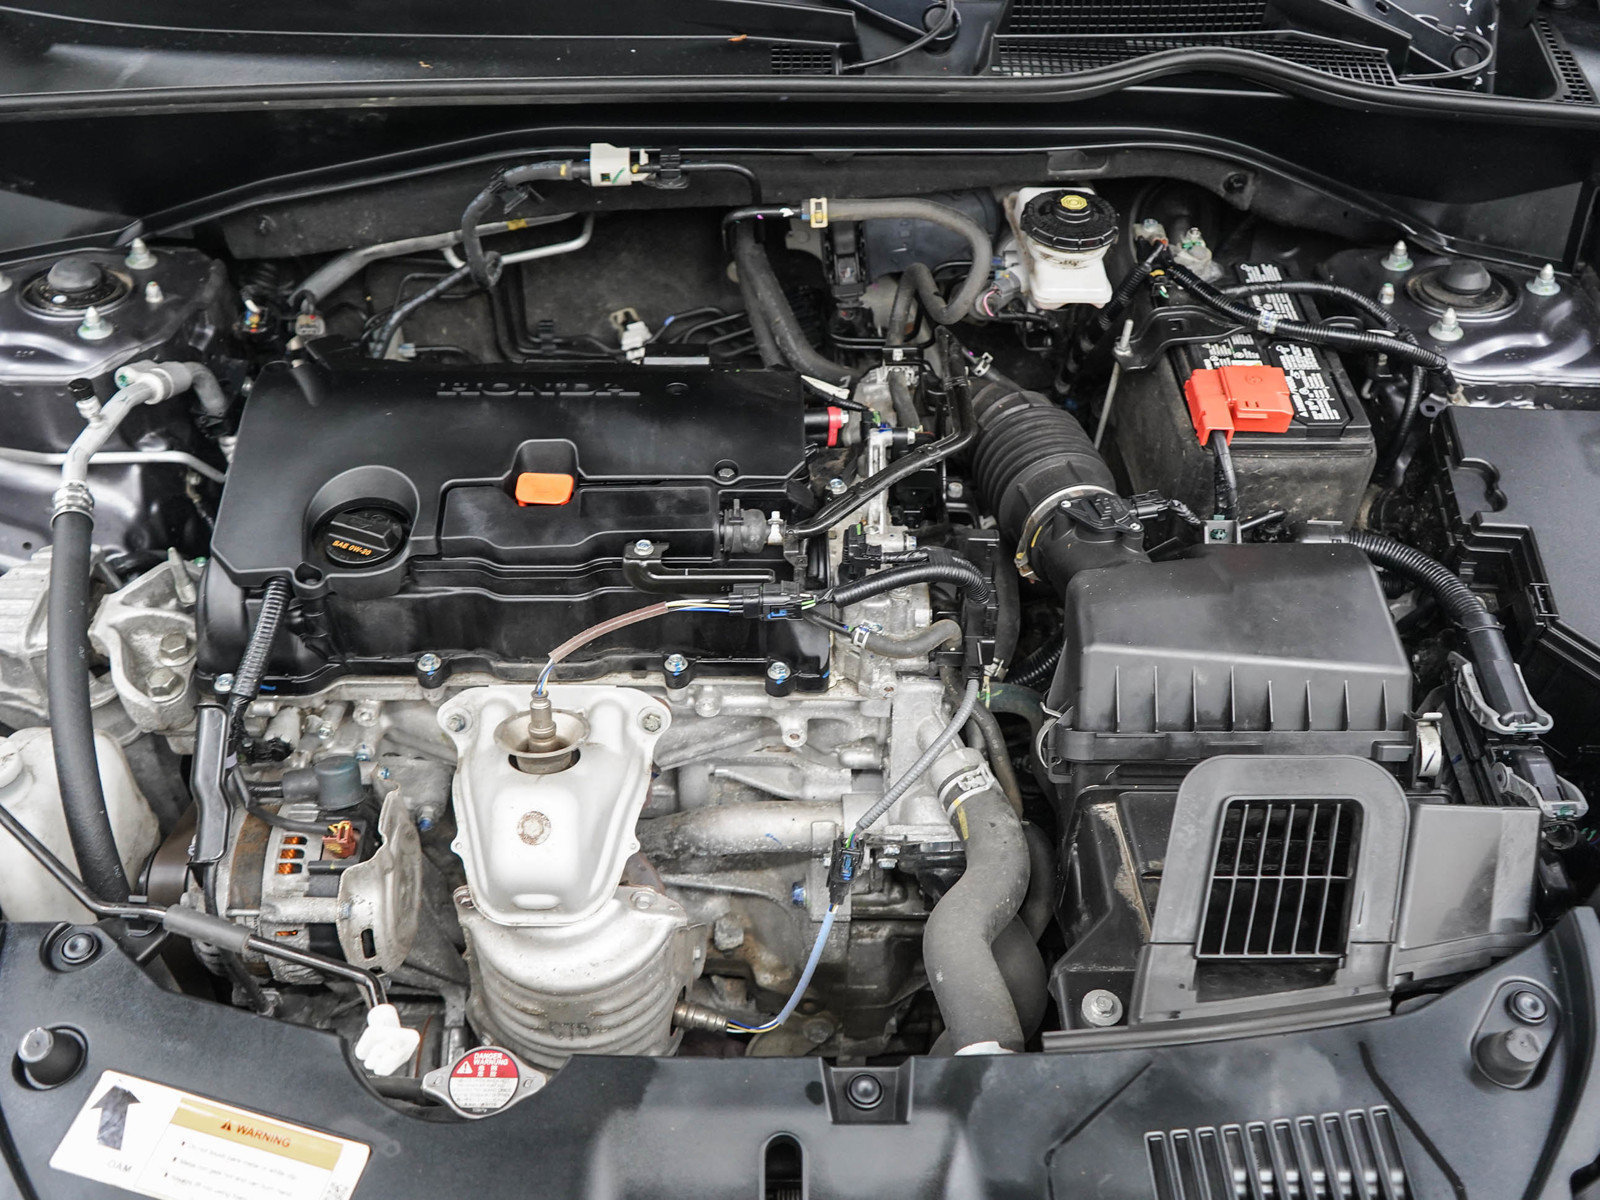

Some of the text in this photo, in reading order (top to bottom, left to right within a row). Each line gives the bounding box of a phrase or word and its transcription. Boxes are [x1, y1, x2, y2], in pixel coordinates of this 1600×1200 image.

[436, 381, 640, 397] HONDA
[473, 1052, 503, 1060] DANGER
[473, 1058, 509, 1066] WARNING
[236, 1124, 292, 1148] WARNING
